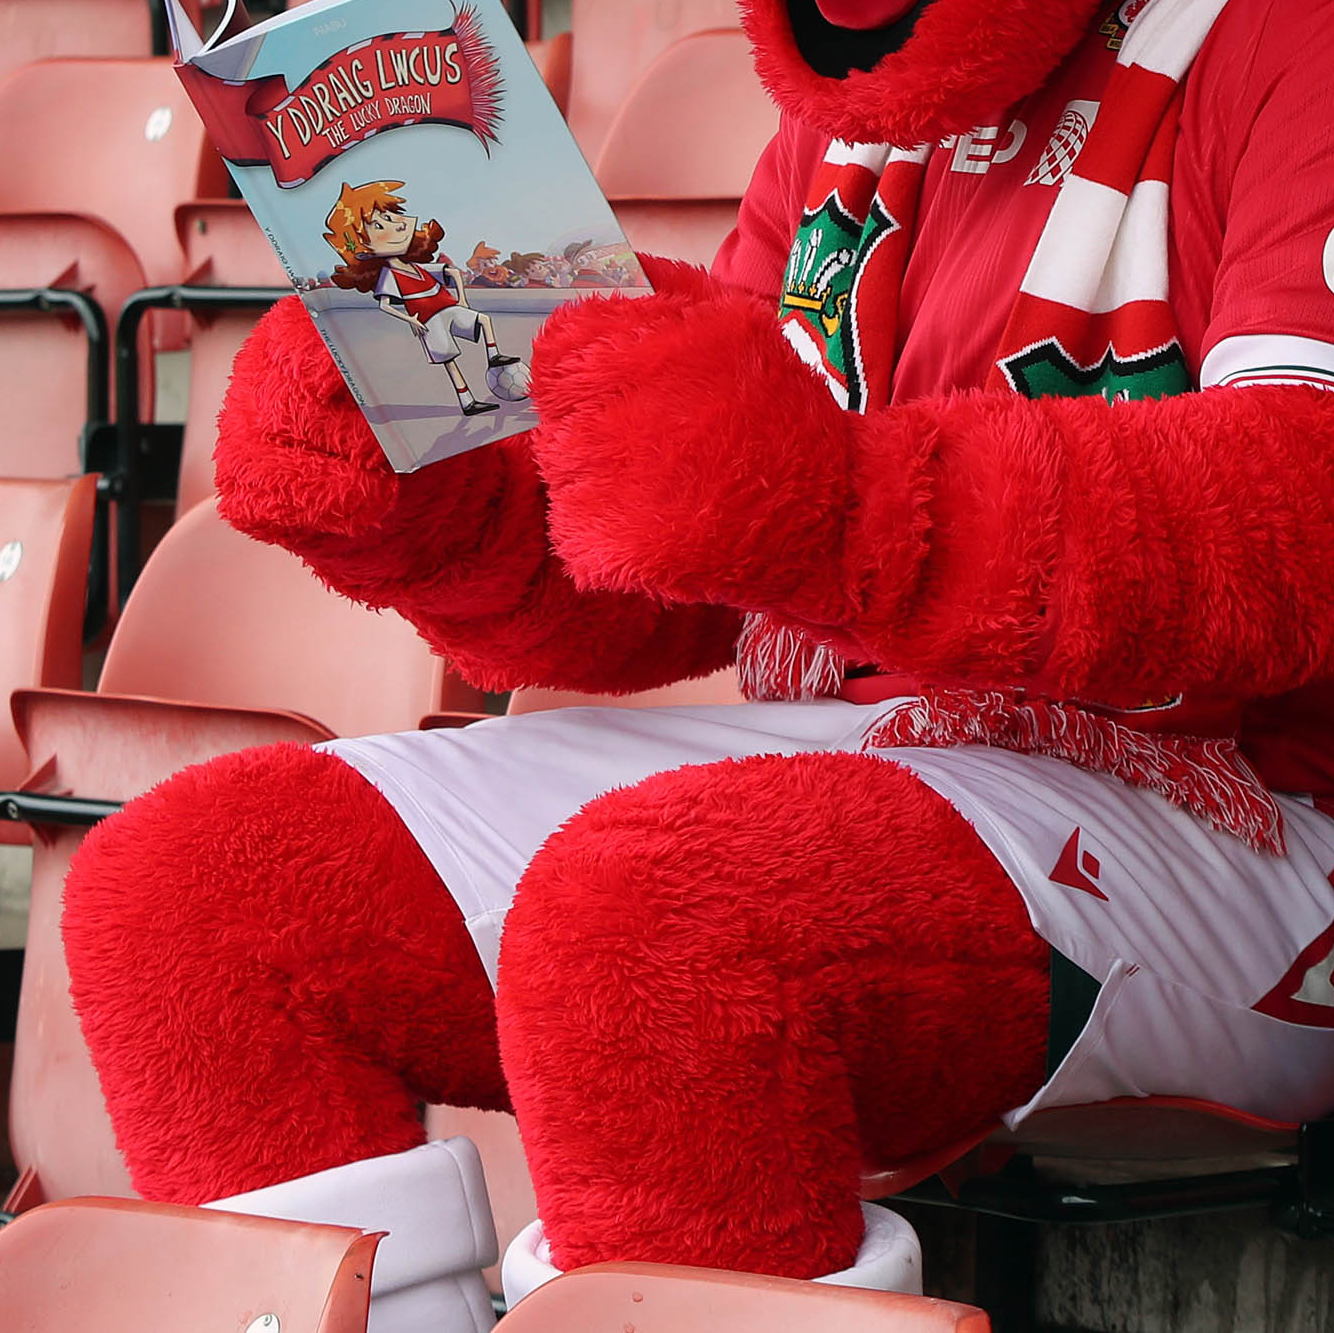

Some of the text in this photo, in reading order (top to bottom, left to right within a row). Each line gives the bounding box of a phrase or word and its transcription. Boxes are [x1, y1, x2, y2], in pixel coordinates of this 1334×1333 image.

[267, 42, 462, 159] Y DDRAIG LWCUS
[321, 91, 432, 148] THE LUCKY DRAGON
